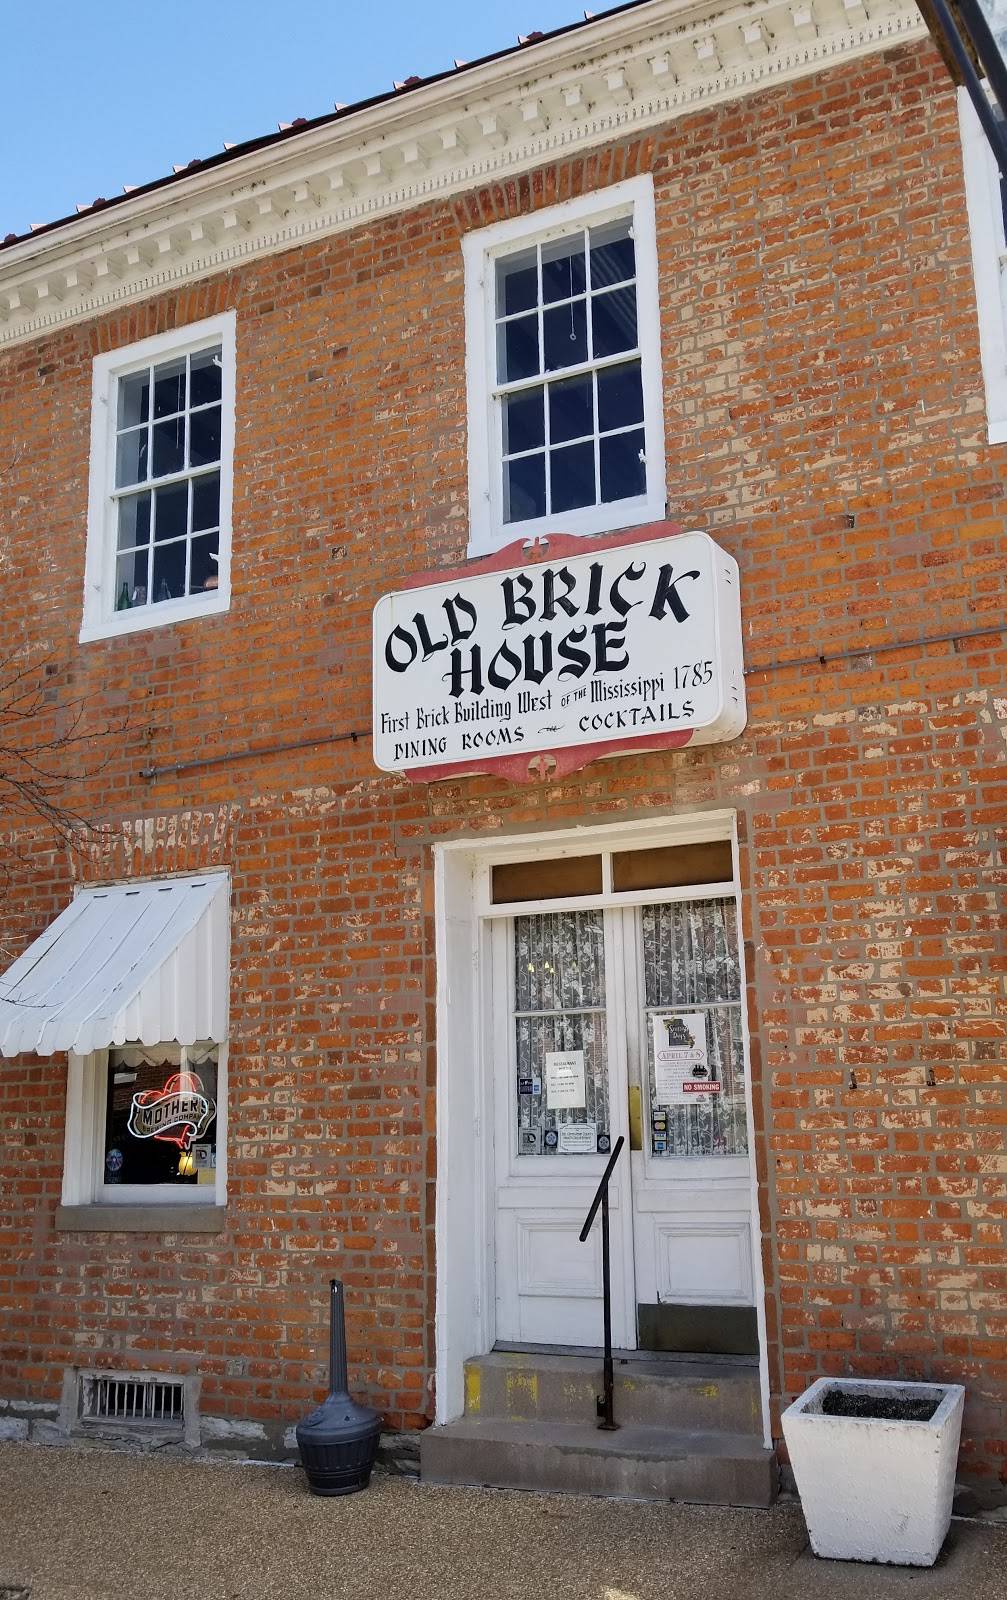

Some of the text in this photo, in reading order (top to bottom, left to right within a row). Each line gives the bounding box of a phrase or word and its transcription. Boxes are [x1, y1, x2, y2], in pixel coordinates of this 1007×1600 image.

[385, 560, 701, 673] OLD BRICK
[441, 617, 630, 698] HOUSE
[381, 660, 713, 734] First Brick Building West OF THE Mississippi 1785
[393, 700, 695, 761] DINING ROOMS COCKTAILS
[683, 1083, 693, 1091] NO
[693, 1083, 720, 1091] SMOKING
